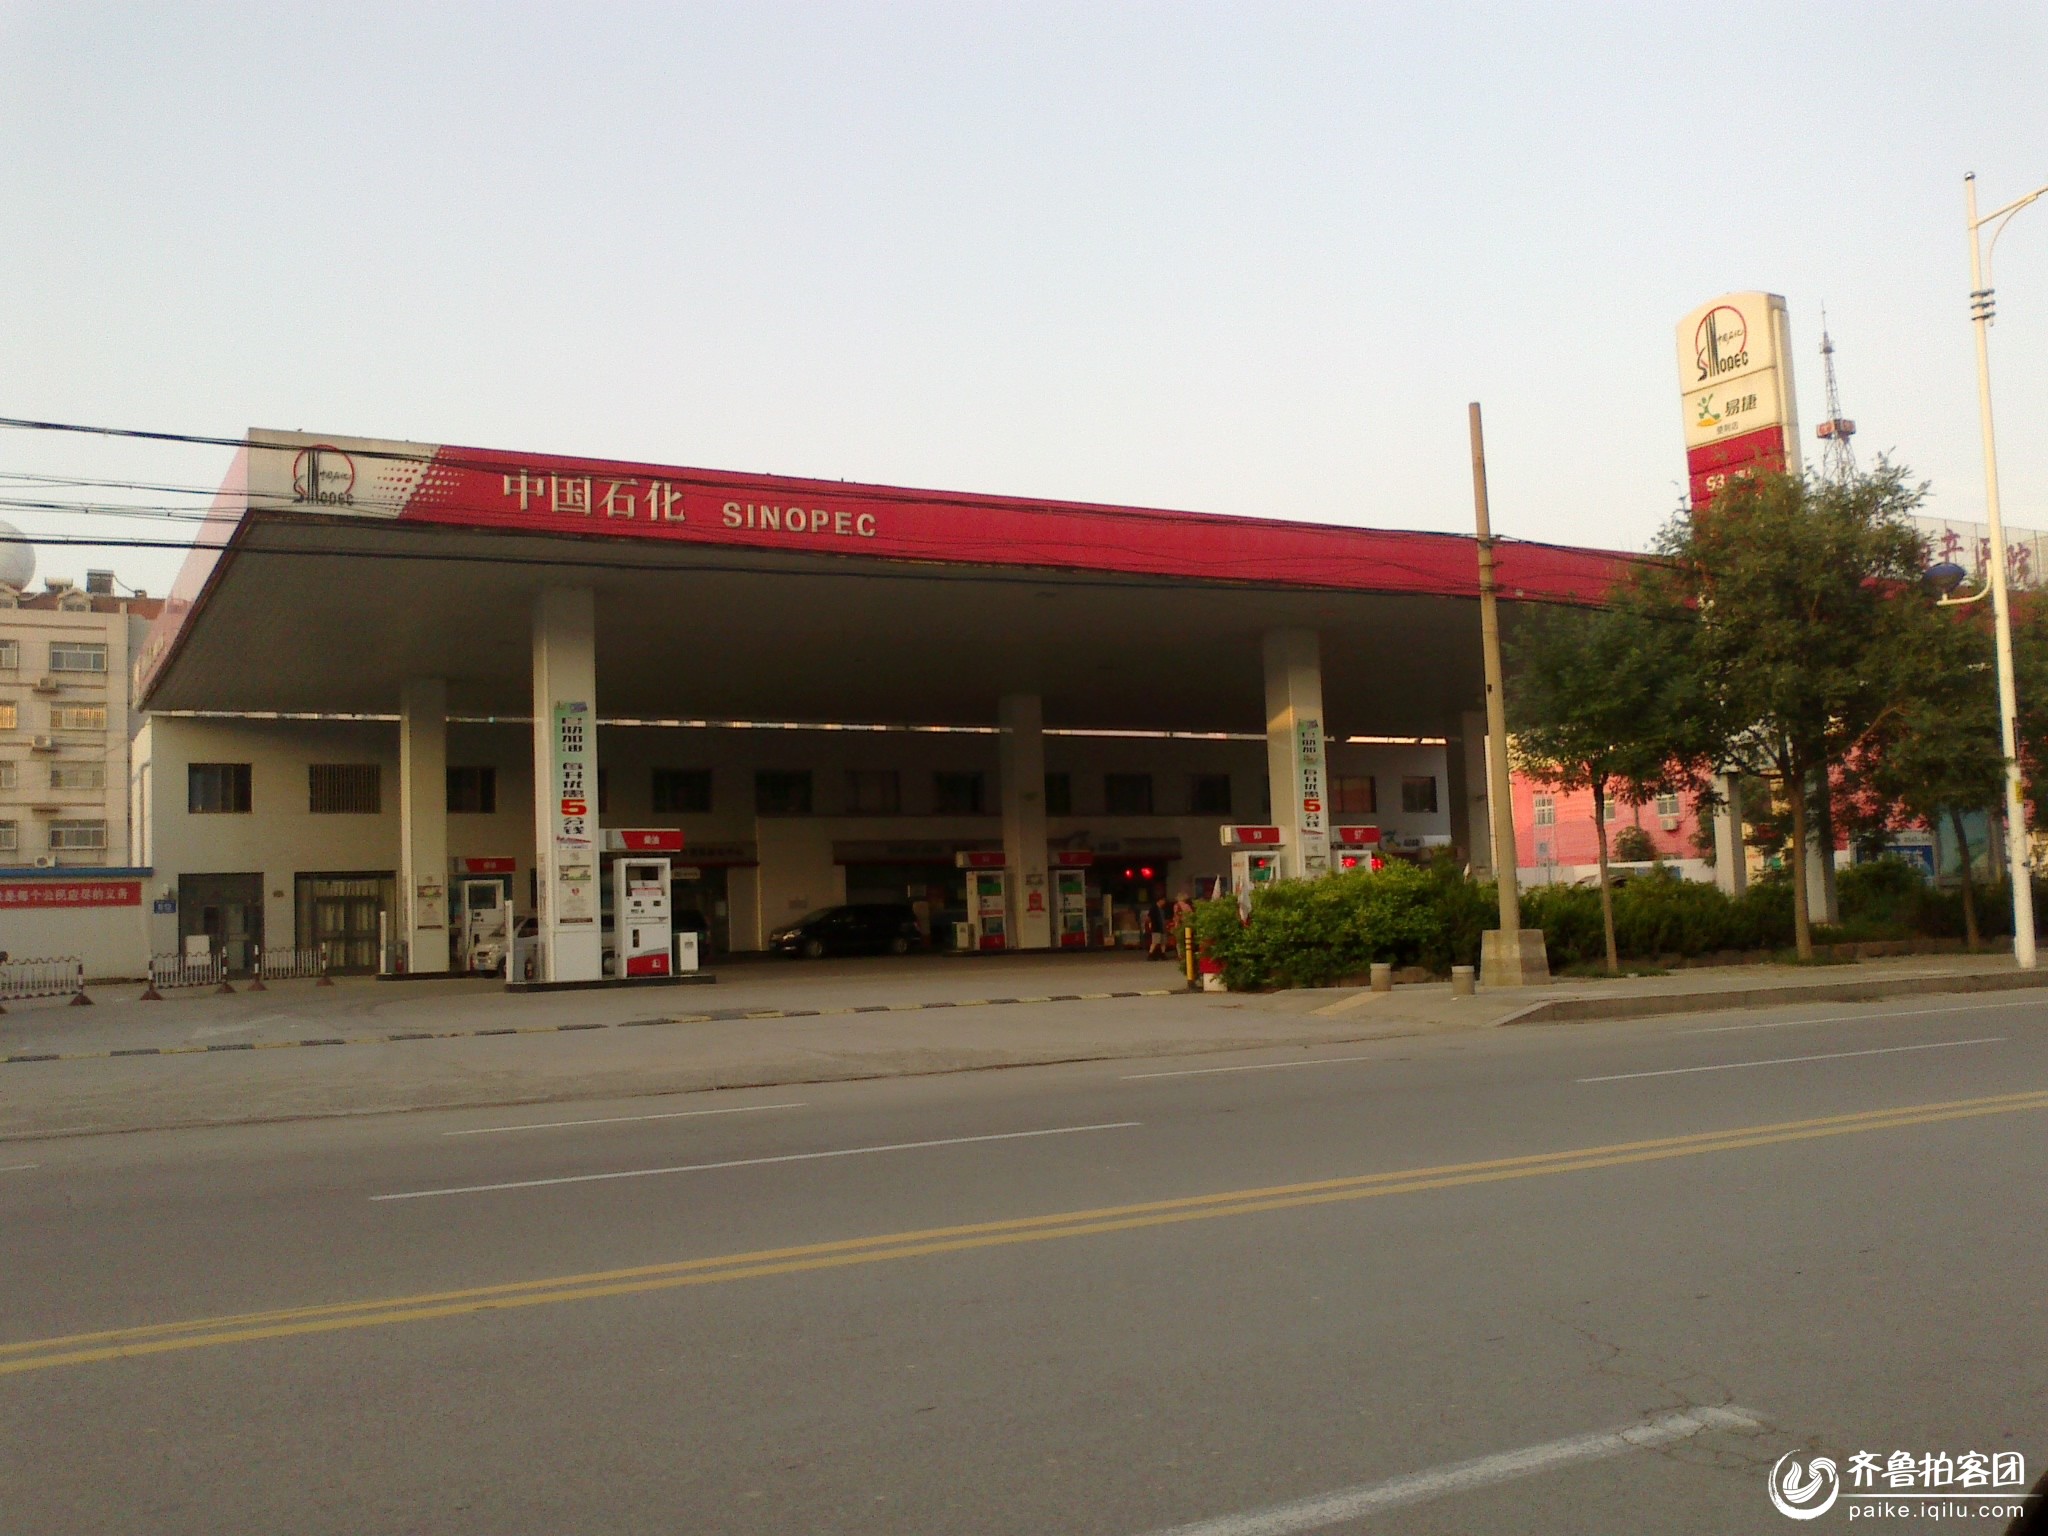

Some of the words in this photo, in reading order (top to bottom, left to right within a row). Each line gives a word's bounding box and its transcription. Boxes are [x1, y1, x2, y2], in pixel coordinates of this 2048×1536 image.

[1725, 393, 1757, 417] 易捷
[503, 469, 686, 522] 中国石化
[1706, 473, 1725, 491] 93
[722, 502, 878, 537] SINOPEC
